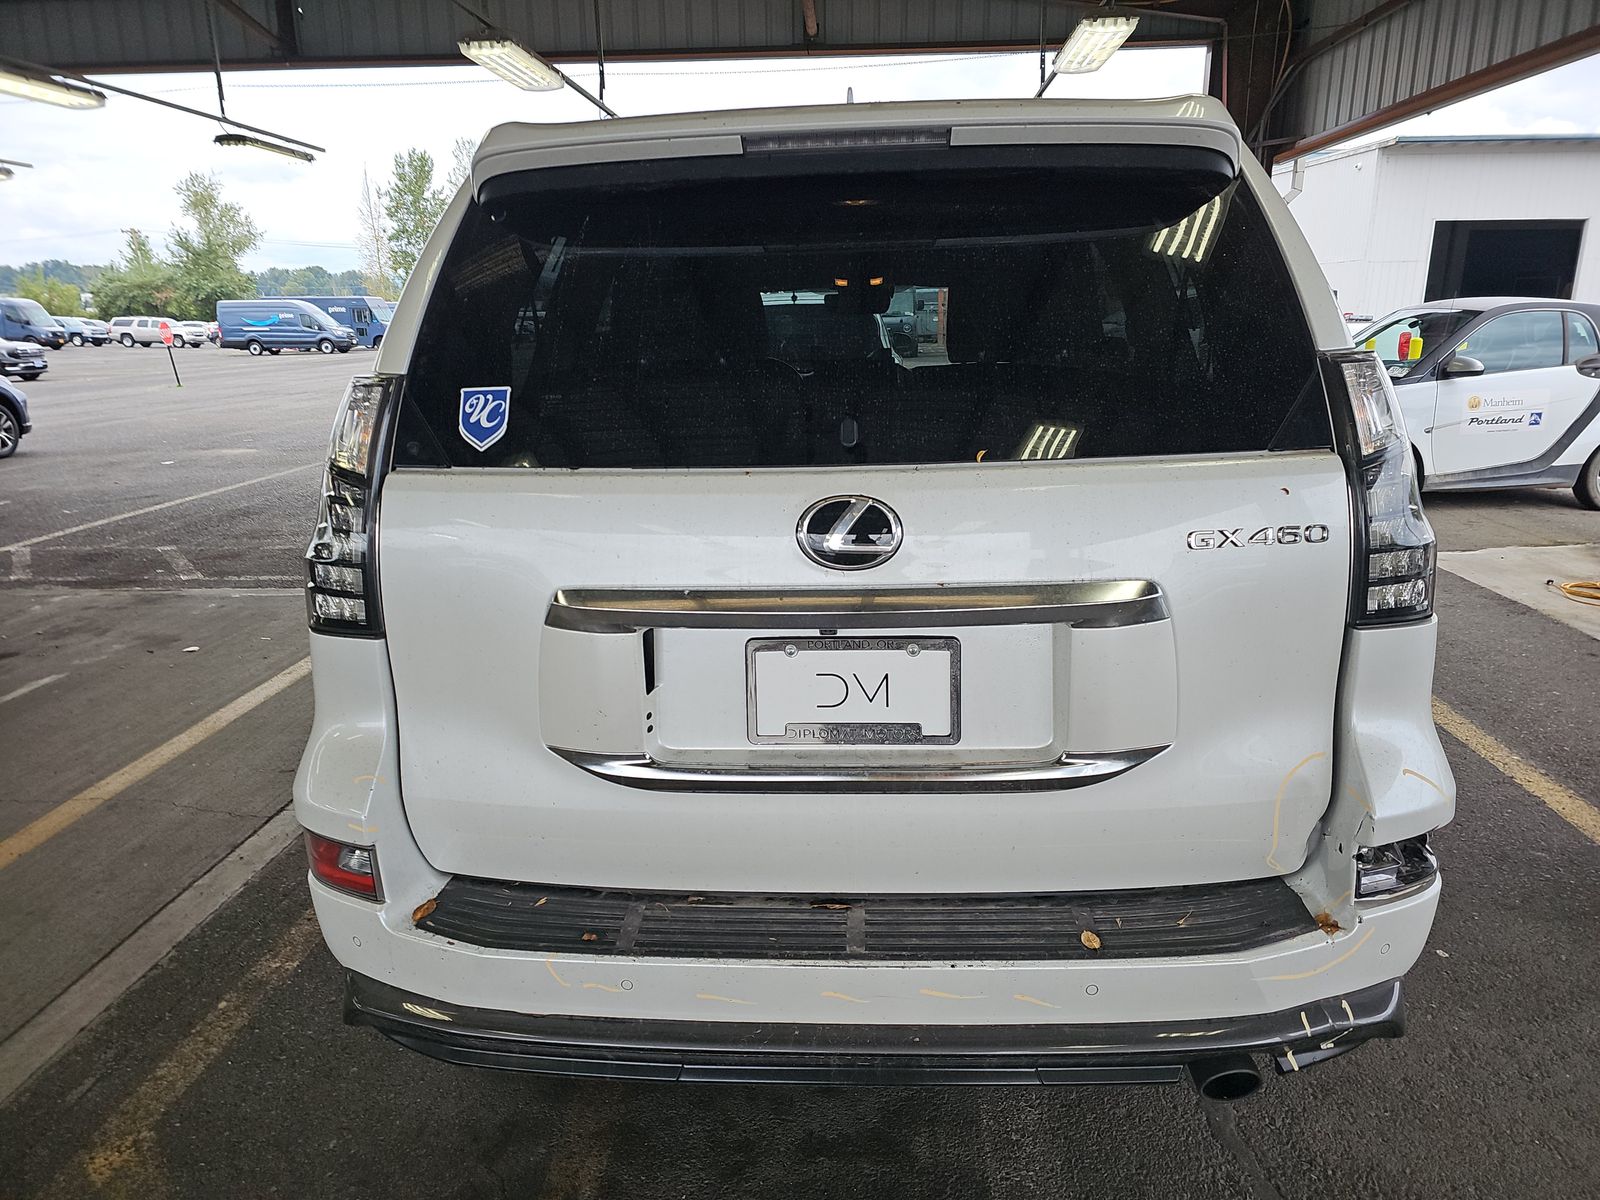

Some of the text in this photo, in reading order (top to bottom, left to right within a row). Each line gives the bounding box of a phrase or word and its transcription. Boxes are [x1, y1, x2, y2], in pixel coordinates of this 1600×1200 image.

[328, 305, 347, 313] prime
[1483, 397, 1524, 408] Manheim
[1467, 414, 1525, 426] Portland
[807, 639, 894, 650] PORTLAND, OR
[815, 672, 890, 708] DM
[787, 727, 921, 740] DIPLOMAT MOTORS
